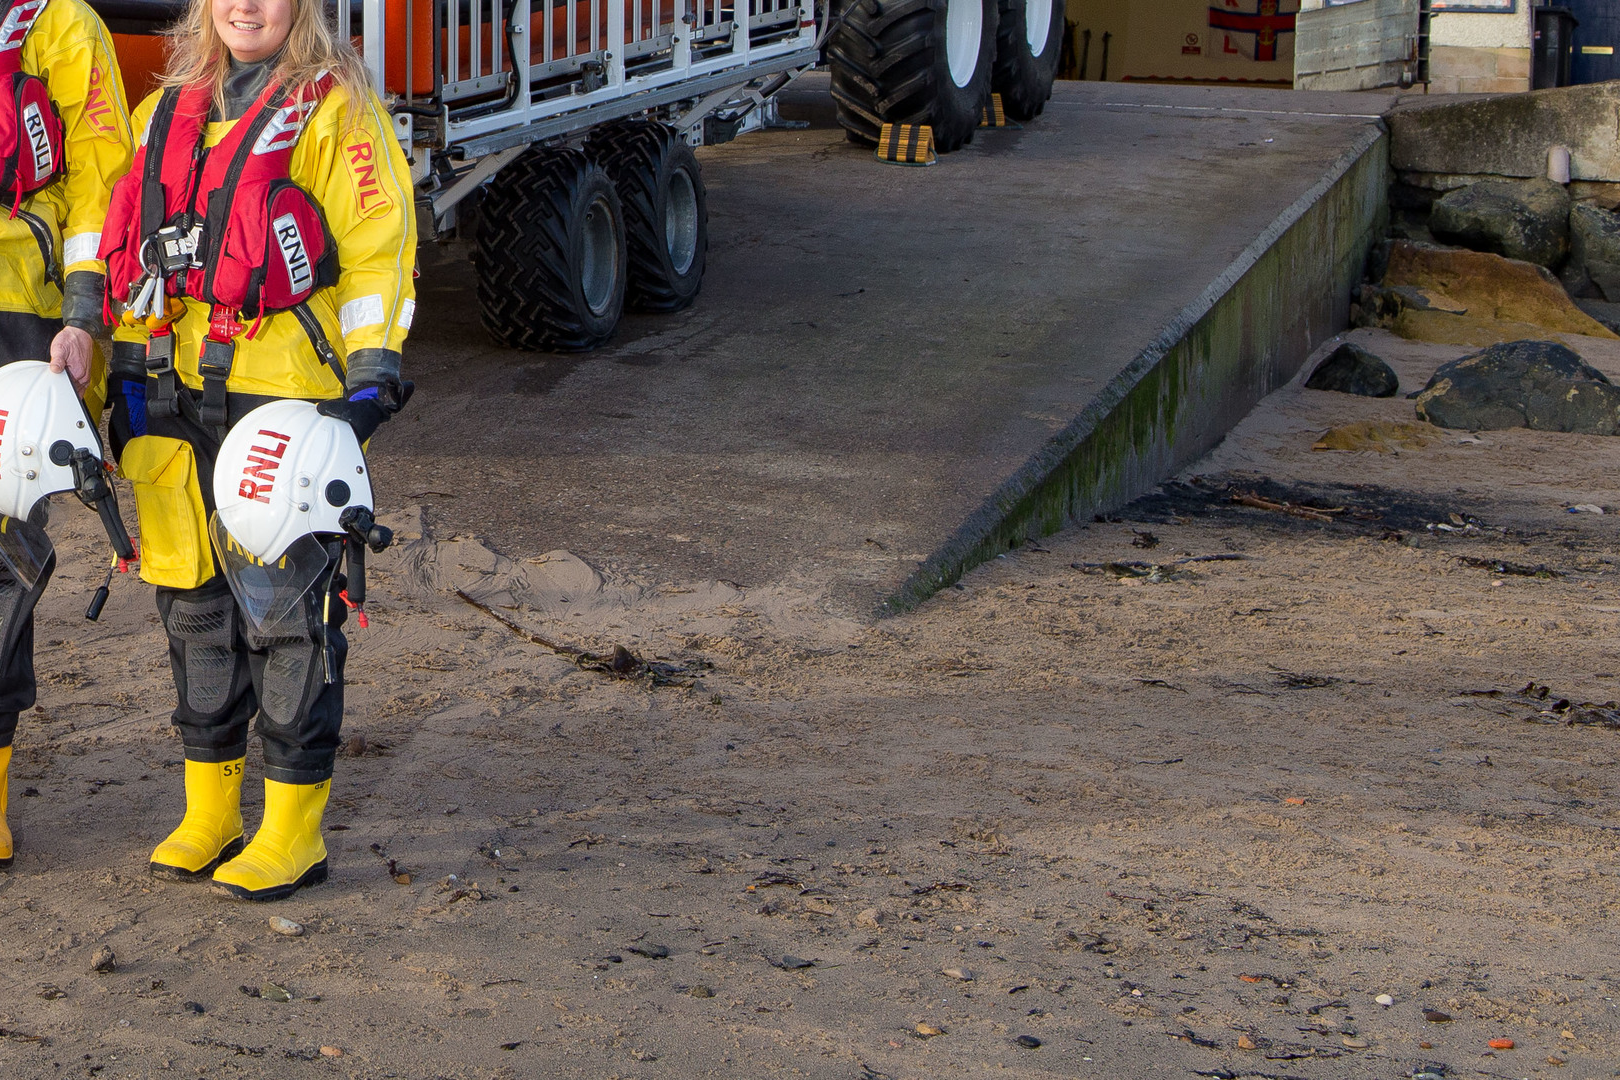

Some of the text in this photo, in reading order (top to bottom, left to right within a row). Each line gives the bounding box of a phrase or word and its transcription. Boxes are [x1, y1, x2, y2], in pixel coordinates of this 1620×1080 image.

[1223, 35, 1238, 54] L
[26, 113, 53, 171] RNLI
[346, 141, 387, 214] RNLI
[278, 223, 311, 285] RNLI
[238, 429, 291, 505] RNLI
